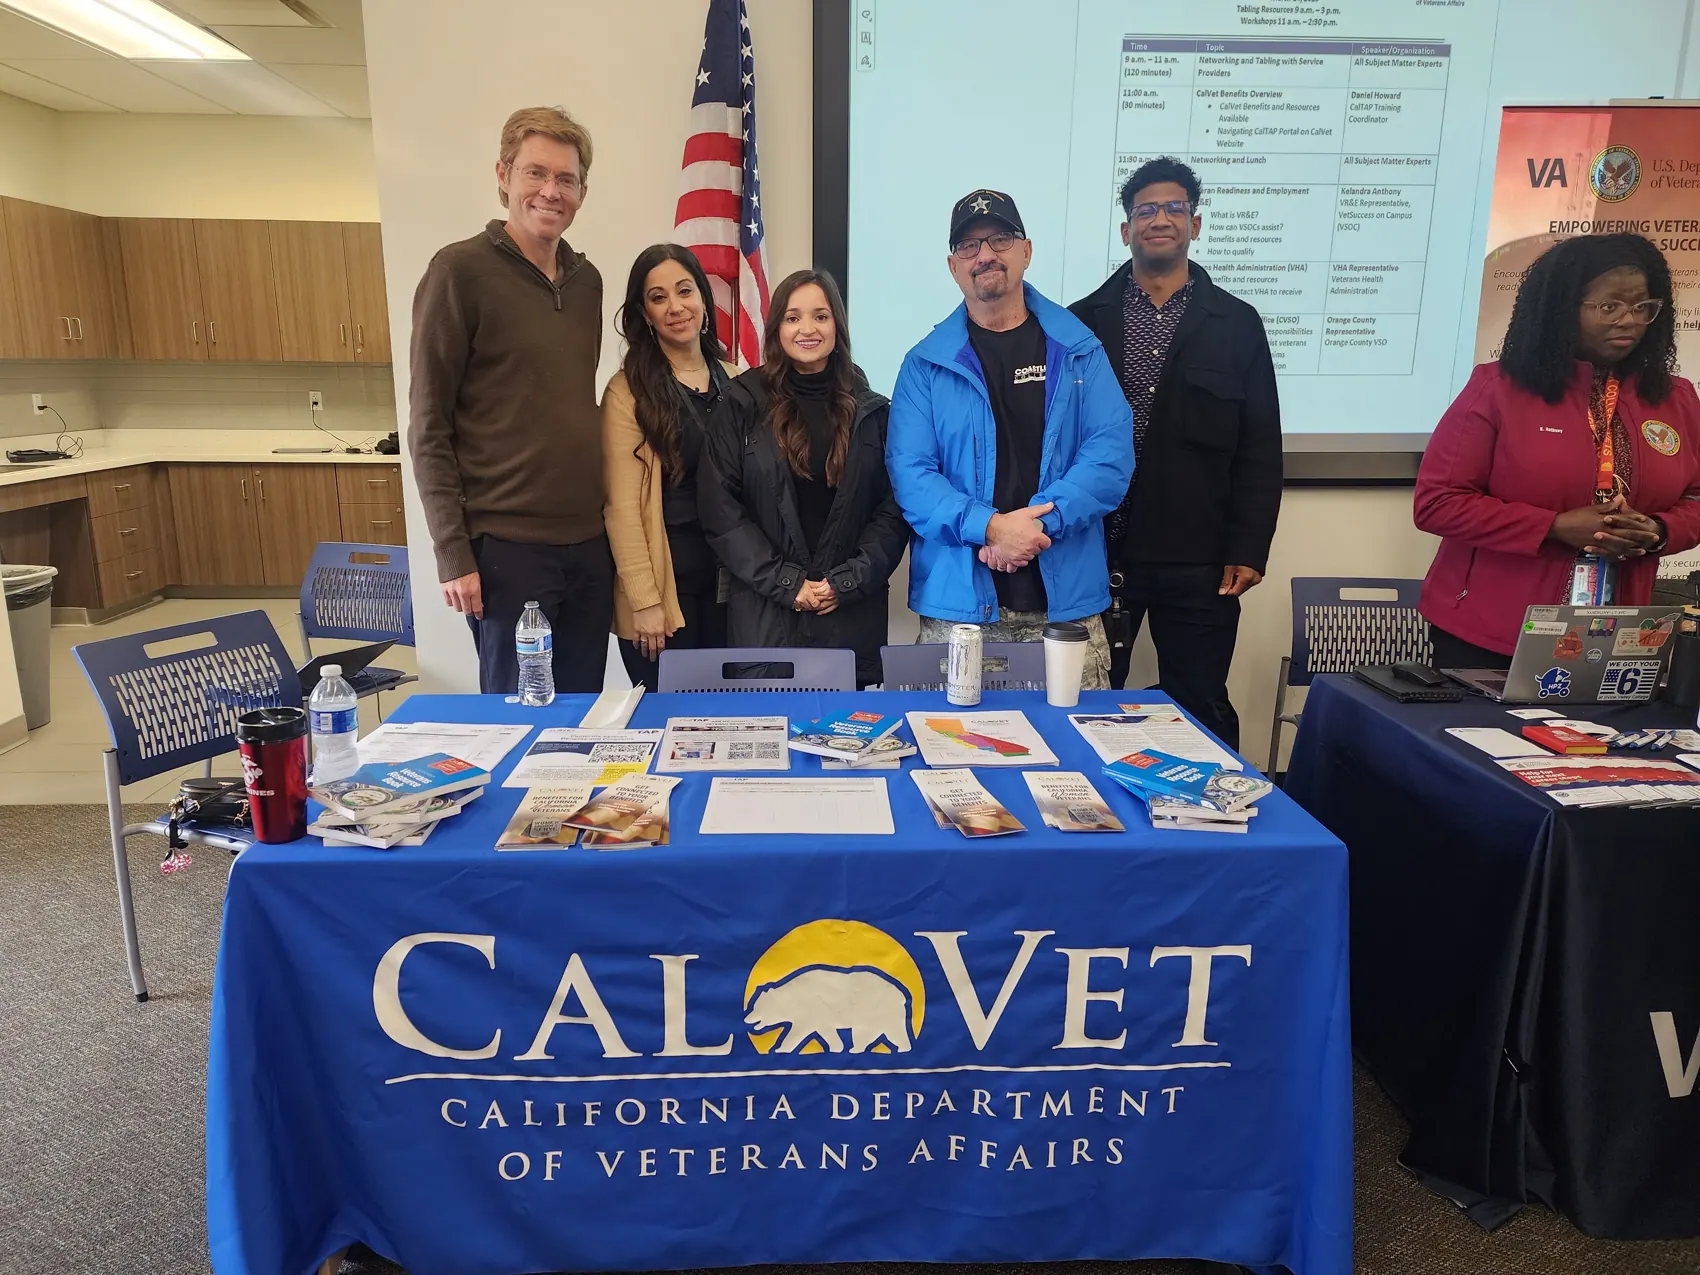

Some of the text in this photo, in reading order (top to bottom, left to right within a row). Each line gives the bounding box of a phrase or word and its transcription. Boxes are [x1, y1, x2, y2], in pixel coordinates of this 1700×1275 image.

[1447, 0, 1465, 8] Affairs
[1237, 5, 1260, 15] Tabling
[1261, 6, 1294, 14] Resources
[1326, 8, 1341, 17] p.m.
[1241, 17, 1277, 27] Workshops
[1308, 19, 1322, 27] 2:30
[1323, 20, 1338, 28] p.m.
[1130, 42, 1148, 51] Time
[1206, 44, 1225, 52] Topic
[1361, 46, 1436, 56] Speaker/Organization
[1154, 56, 1163, 64] 11
[1198, 56, 1239, 66] Networking
[1240, 56, 1254, 65] and
[1256, 57, 1280, 67] Tabling
[1298, 58, 1324, 66] Service
[1365, 59, 1390, 68] Subject
[1392, 60, 1416, 68] Matter
[1416, 60, 1442, 69] Experts
[1124, 68, 1172, 78] (120 minutes)
[1198, 69, 1231, 78] Providers
[1122, 89, 1159, 98] 11:00 a.m.
[1196, 90, 1282, 98] CalVet Benefits Overview
[1351, 91, 1402, 100] Daniel Howard
[1134, 101, 1166, 110] minutes)
[1219, 102, 1242, 110] CalVet
[1242, 103, 1270, 111] Benefits
[1286, 104, 1320, 112] Resources
[1350, 104, 1402, 113] CalTAP Training
[1218, 114, 1249, 122] Available
[1348, 115, 1388, 124] Coordinator
[1218, 128, 1332, 137] Navigating CalTAP Portal CalVet
[1216, 140, 1244, 148] Website
[1190, 156, 1230, 165] Networking
[1232, 156, 1245, 164] and
[1344, 156, 1354, 164] All
[1354, 157, 1380, 166] Subject
[1406, 158, 1432, 166] Experts
[1652, 160, 1676, 172] U.S.
[1526, 158, 1568, 188] VA
[1650, 176, 1665, 189] of
[1216, 187, 1250, 195] Readiness
[1266, 187, 1310, 196] Employment
[1340, 187, 1402, 196] Kelandra Anthony
[1360, 199, 1411, 208] Representative,
[1236, 211, 1259, 219] VR&E?
[1338, 211, 1375, 219] VetSuccess
[1386, 212, 1412, 220] Campus
[1261, 223, 1284, 231] assist?
[1337, 223, 1360, 232] (VSOC)
[1549, 220, 1700, 233] EMPOWERING VETER
[1208, 235, 1234, 243] Benefits
[1232, 248, 1254, 256] qualify
[1212, 264, 1235, 272] Health
[1236, 264, 1286, 272] Administration
[1287, 264, 1308, 272] (VHA)
[1348, 264, 1400, 272] Representative
[1332, 275, 1360, 283] Veterans
[1330, 286, 1378, 294] Administration
[1276, 316, 1300, 325] (CVSO)
[1326, 316, 1376, 325] Orange County
[1266, 328, 1313, 336] responsibilities
[1326, 328, 1376, 336] Representative
[1324, 338, 1348, 347] Orange
[1349, 338, 1372, 347] County
[1616, 668, 1642, 696] 6
[440, 1086, 1185, 1129] CALIFORNIA DEPARTMENT
[498, 1134, 1124, 1181] OF VETERANS AFFAIRS
